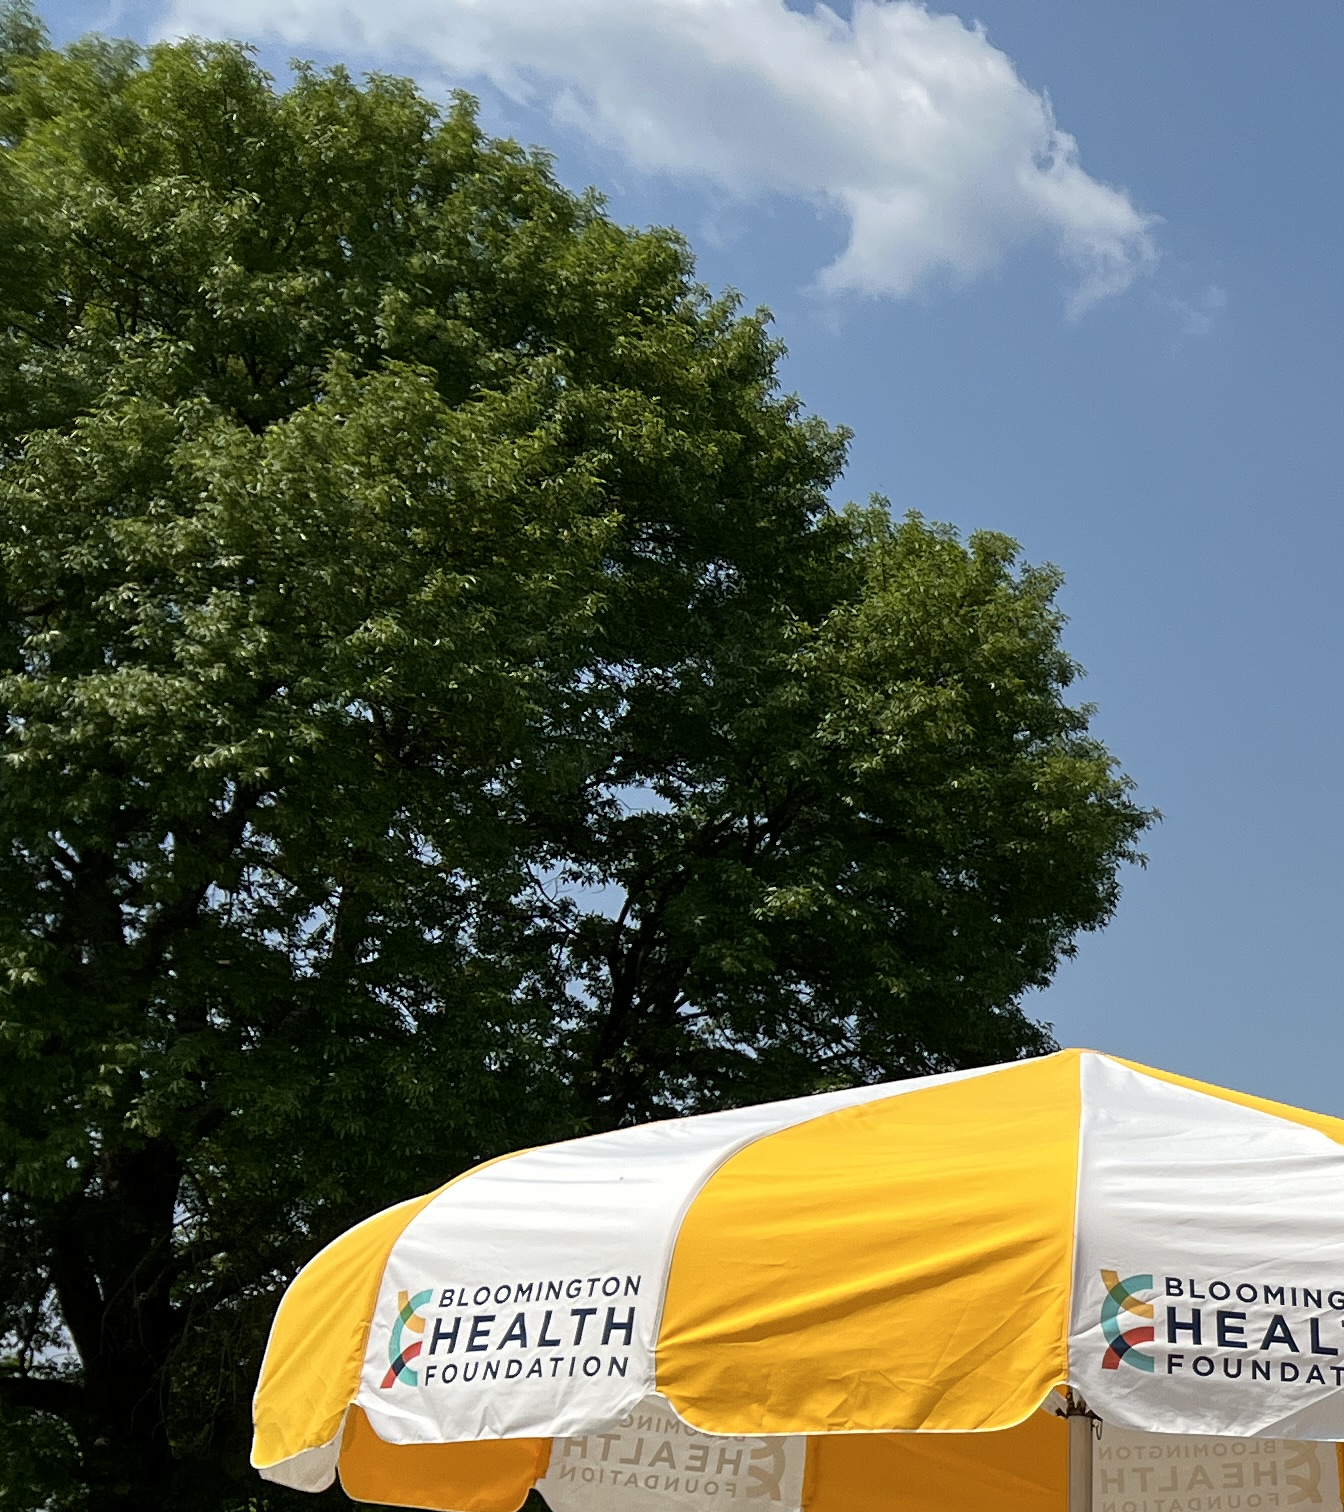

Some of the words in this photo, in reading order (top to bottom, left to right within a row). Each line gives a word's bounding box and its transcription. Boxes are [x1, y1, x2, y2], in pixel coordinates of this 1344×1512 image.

[438, 1275, 642, 1308] BLOOMINGTON
[428, 1306, 636, 1355] HEALTH
[424, 1356, 629, 1387] FOUNDATION
